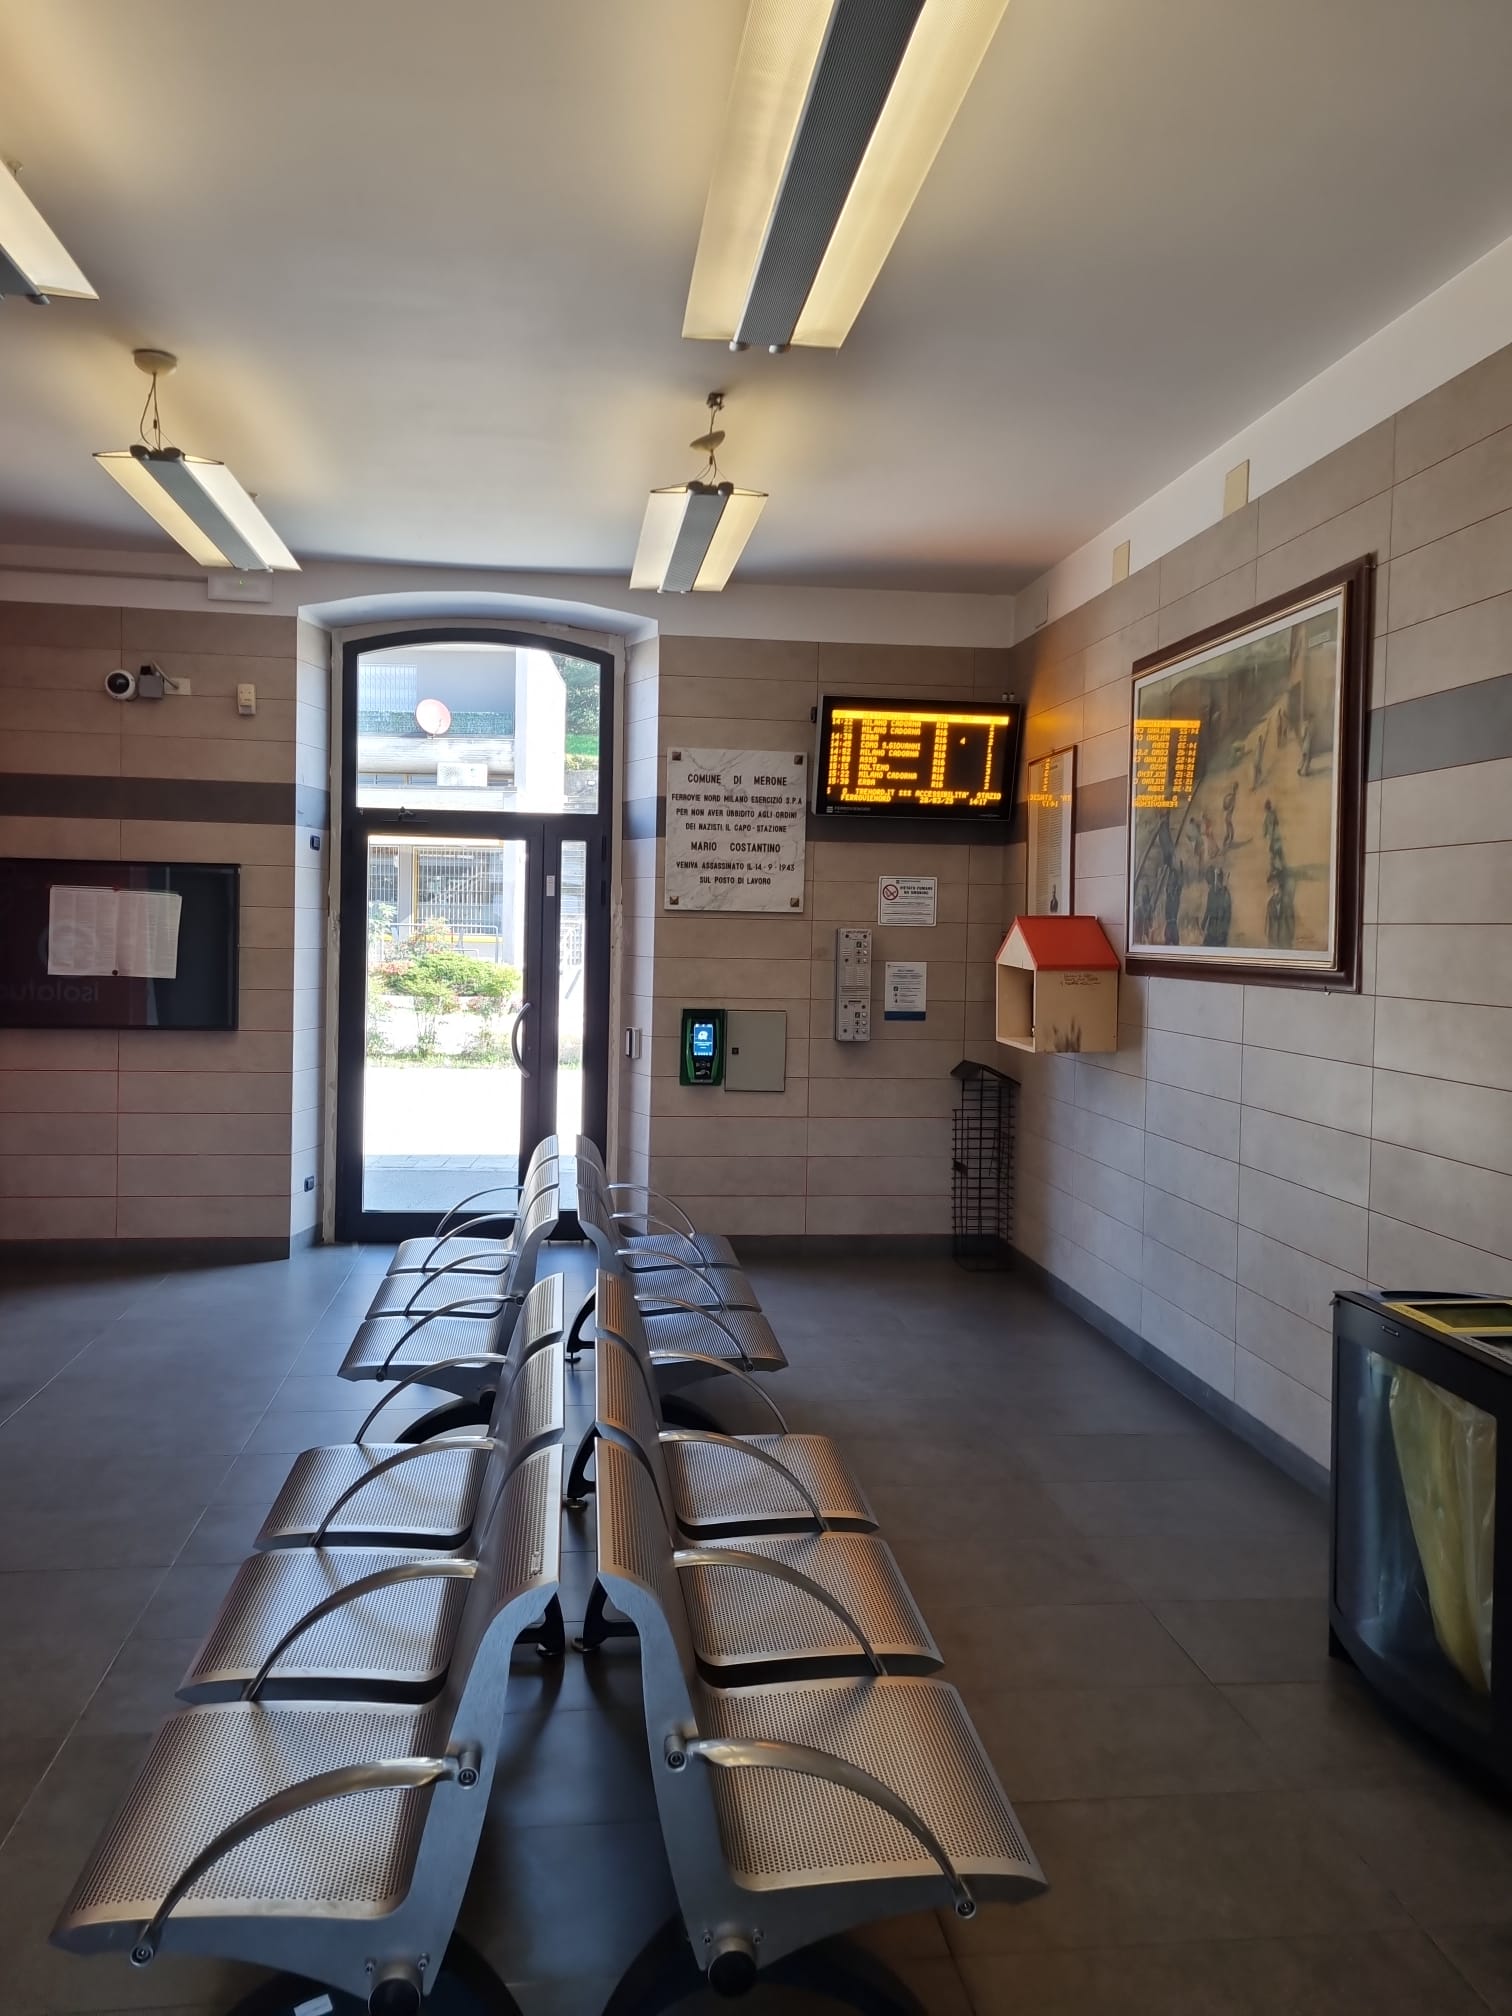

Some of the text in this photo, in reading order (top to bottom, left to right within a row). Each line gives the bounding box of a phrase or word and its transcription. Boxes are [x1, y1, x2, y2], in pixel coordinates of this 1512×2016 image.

[882, 742, 920, 750] S.GIOVANNI
[688, 774, 787, 785] COMUNE DI MERONE
[724, 795, 748, 803] MILANO
[691, 842, 780, 853] MARIO COSTANTINO
